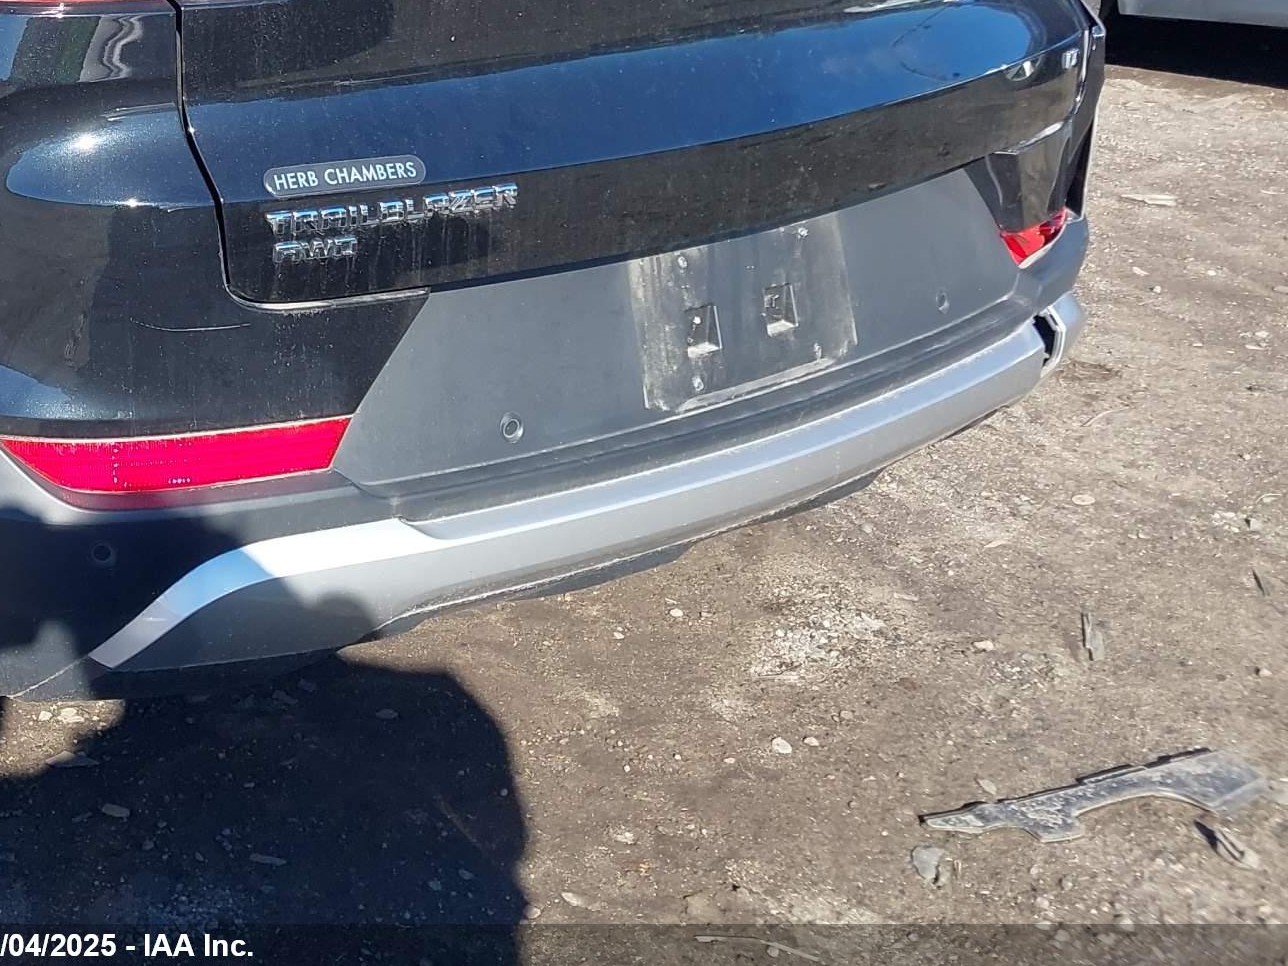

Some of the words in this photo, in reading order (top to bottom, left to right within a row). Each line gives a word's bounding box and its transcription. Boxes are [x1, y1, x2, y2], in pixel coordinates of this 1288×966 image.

[274, 172, 319, 191] HERB
[324, 161, 418, 185] CHAMBERS
[266, 183, 518, 236] TRAILBLAZER
[273, 235, 358, 264] AWD
